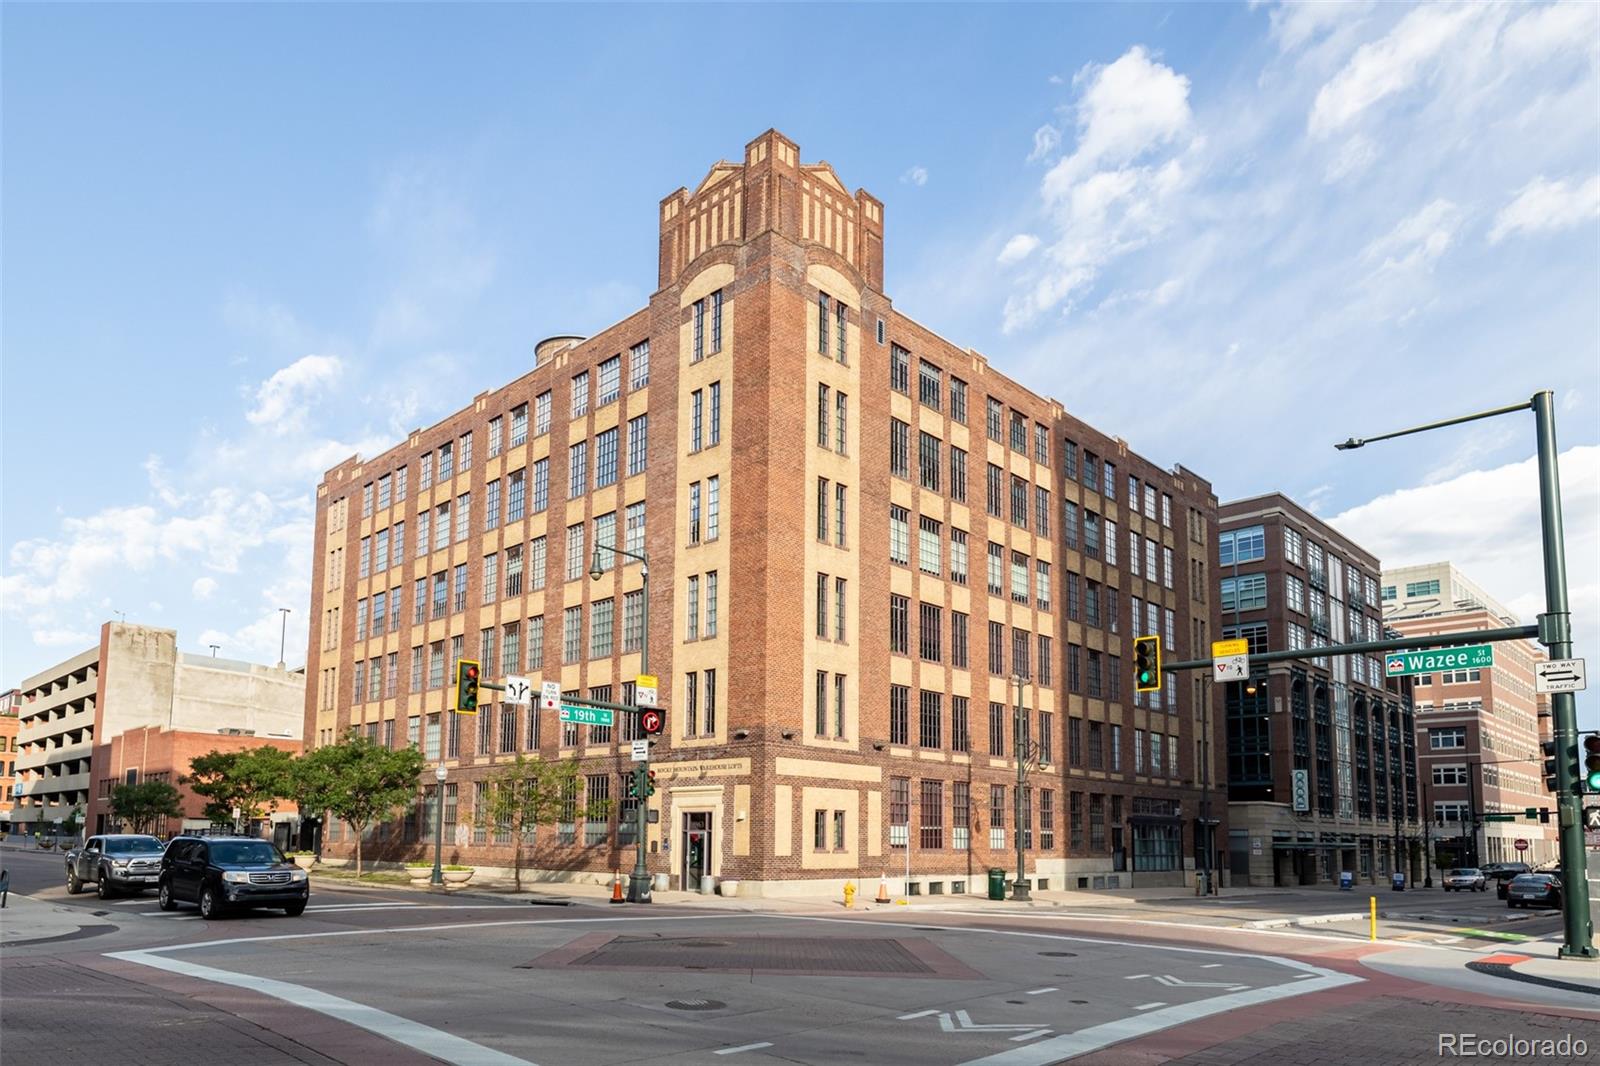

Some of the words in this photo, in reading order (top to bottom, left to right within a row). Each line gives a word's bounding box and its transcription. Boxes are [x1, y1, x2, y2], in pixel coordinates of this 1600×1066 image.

[1408, 652, 1468, 670] Wazee
[1472, 656, 1492, 664] 1600
[574, 710, 596, 722] 19th
